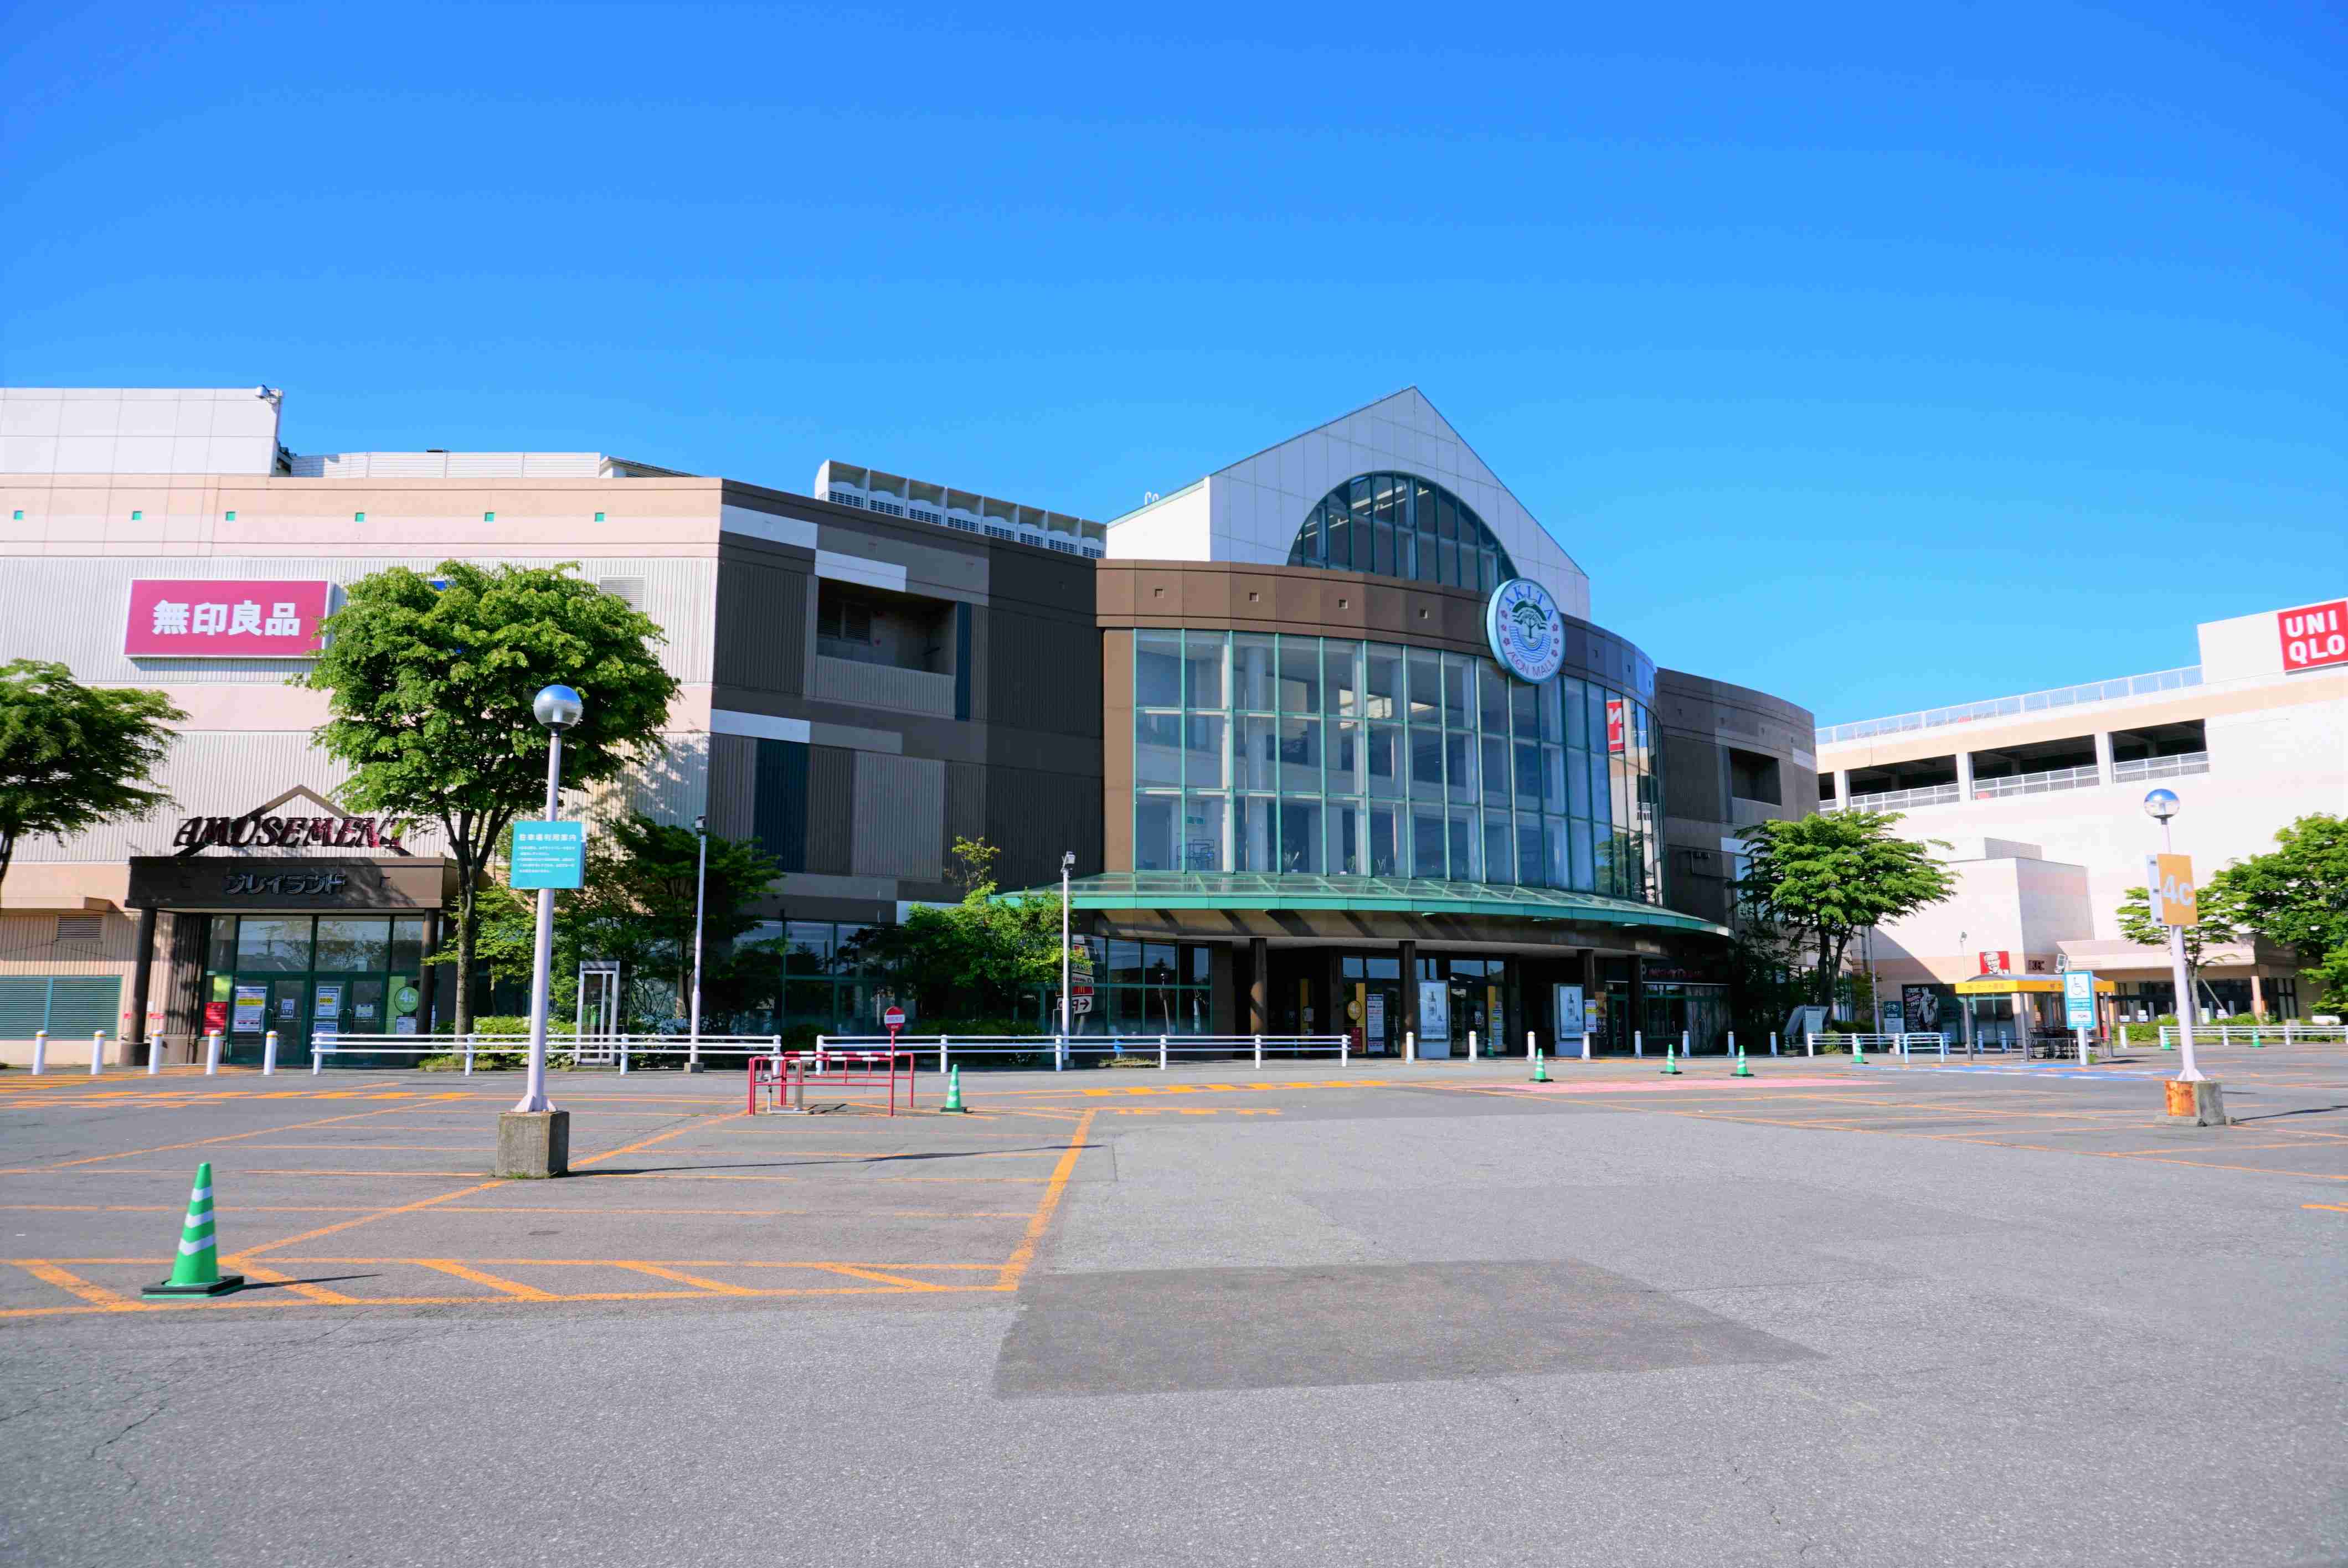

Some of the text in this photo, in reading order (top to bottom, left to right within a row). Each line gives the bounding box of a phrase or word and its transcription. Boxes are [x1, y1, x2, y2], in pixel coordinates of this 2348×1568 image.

[152, 599, 301, 636] 無印良品
[1505, 585, 1554, 621] AKITA
[2285, 610, 2338, 637] UNI
[2289, 635, 2346, 664] QLO
[1532, 659, 1556, 677] MALL
